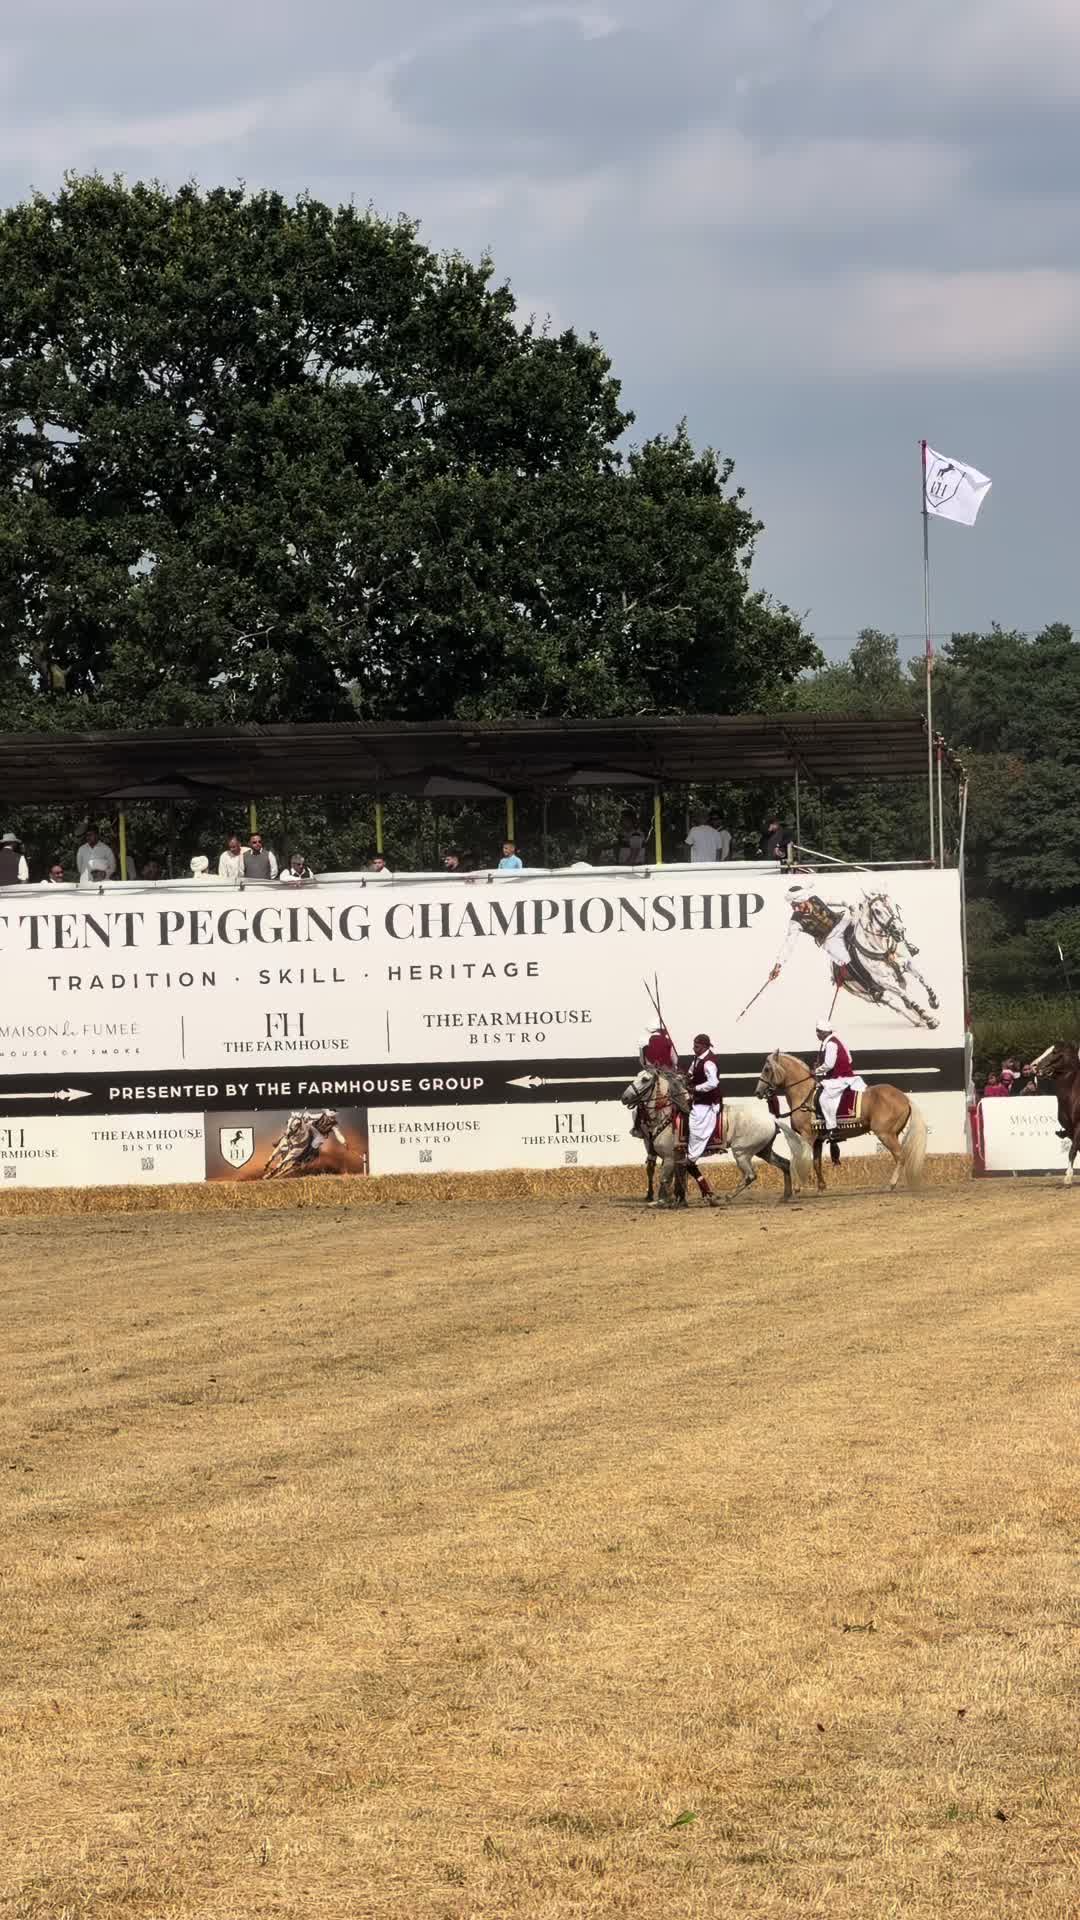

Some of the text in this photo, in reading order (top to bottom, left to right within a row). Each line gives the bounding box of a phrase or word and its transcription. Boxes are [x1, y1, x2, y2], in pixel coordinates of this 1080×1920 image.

[19, 912, 145, 950] TENT
[157, 905, 372, 946] PEGGING
[385, 893, 765, 940] CHAMPIONSHIP
[48, 961, 540, 991] TRADITION SKILL HERITAGE
[265, 1012, 304, 1037] FH
[423, 1009, 592, 1028] THE FARMHOUSE
[0, 1026, 58, 1037] MAISON
[470, 1032, 546, 1045] BISTRO
[91, 1047, 140, 1055] SMOKE
[224, 1039, 349, 1053] THE FARMHOUSE
[109, 1077, 484, 1100] PRESENTED BY THE FARMHOUSE GROUP
[399, 1120, 481, 1132] FARMHOUSE
[120, 1128, 203, 1140] FARMHOUSE
[400, 1135, 451, 1144] BISTRO
[548, 1134, 620, 1144] FARMHOUSE
[0, 1149, 58, 1158] RMHOUSE
[122, 1143, 173, 1152] BISTRO
